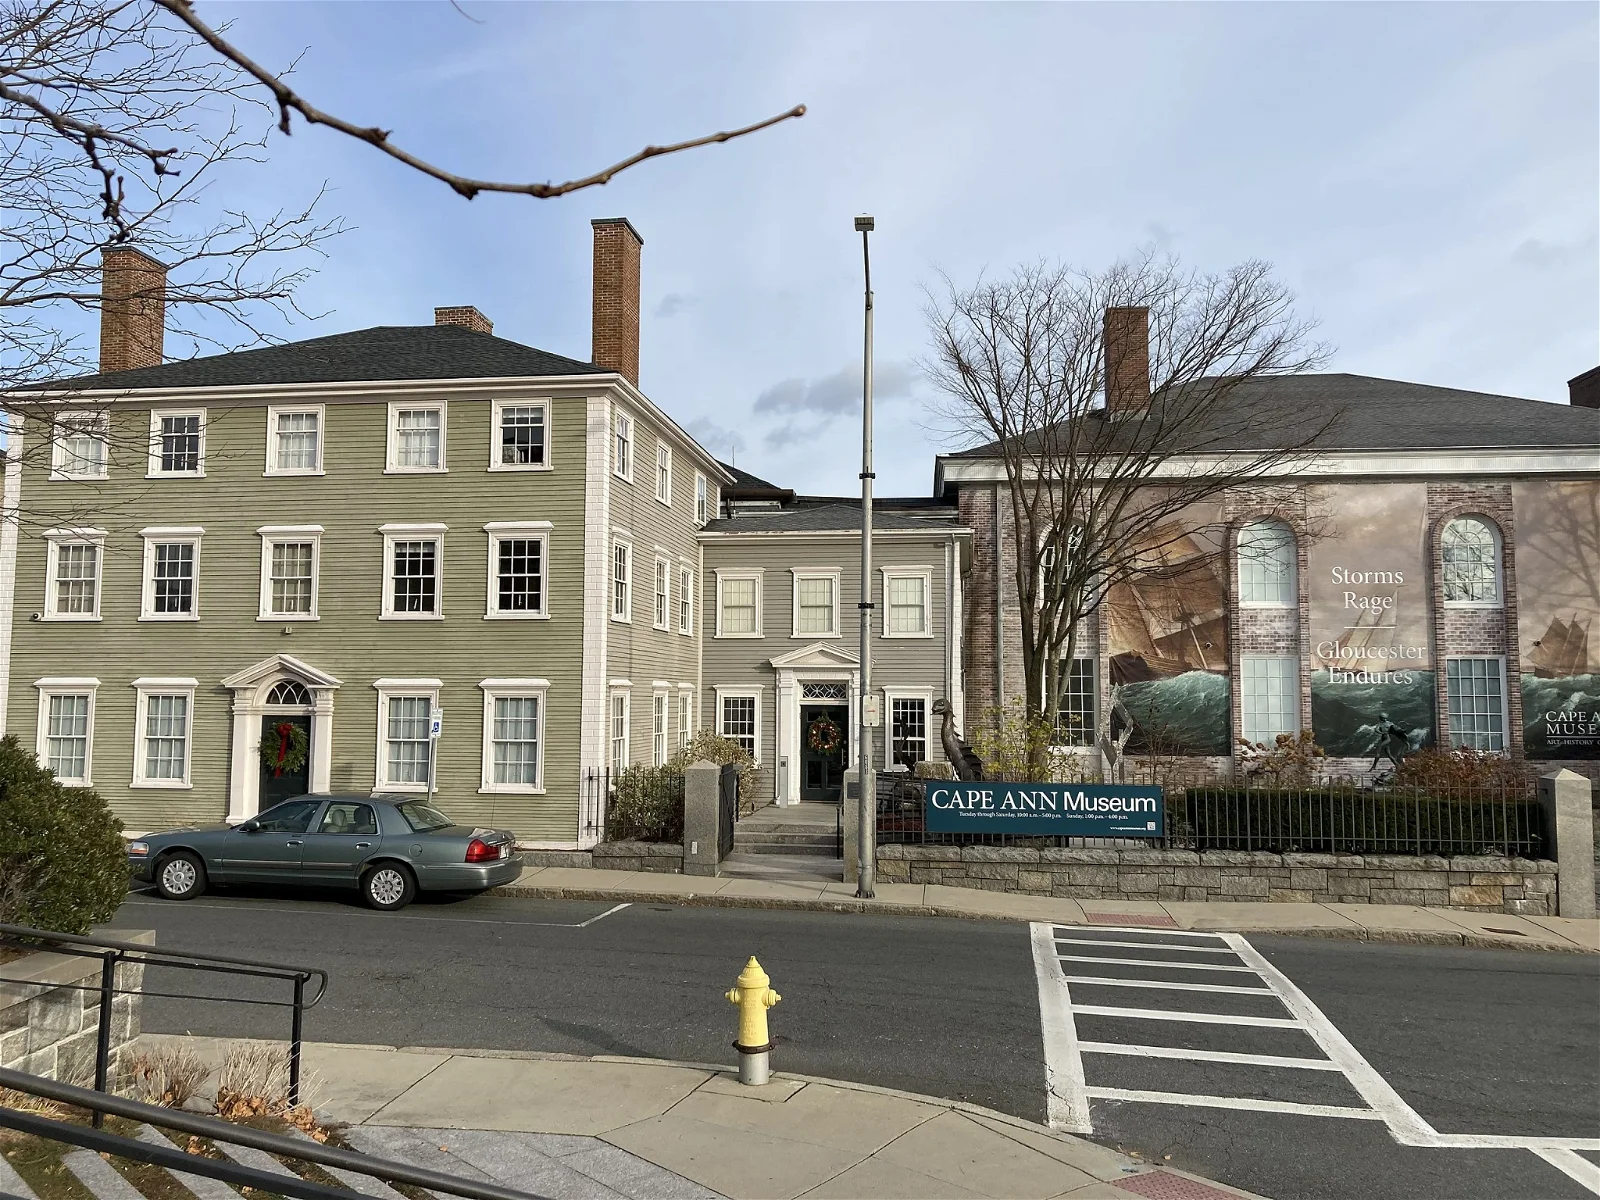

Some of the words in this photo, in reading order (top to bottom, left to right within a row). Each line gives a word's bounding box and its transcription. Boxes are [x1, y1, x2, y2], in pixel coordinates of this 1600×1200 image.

[1331, 566, 1404, 585] Storms
[1343, 591, 1393, 615] Rage
[1316, 640, 1427, 660] Gloucester
[1327, 666, 1413, 684] Endures
[1545, 710, 1587, 722] CAPE
[931, 789, 995, 810] CAPE
[1000, 791, 1058, 810] ANN
[1064, 791, 1156, 812] Museum
